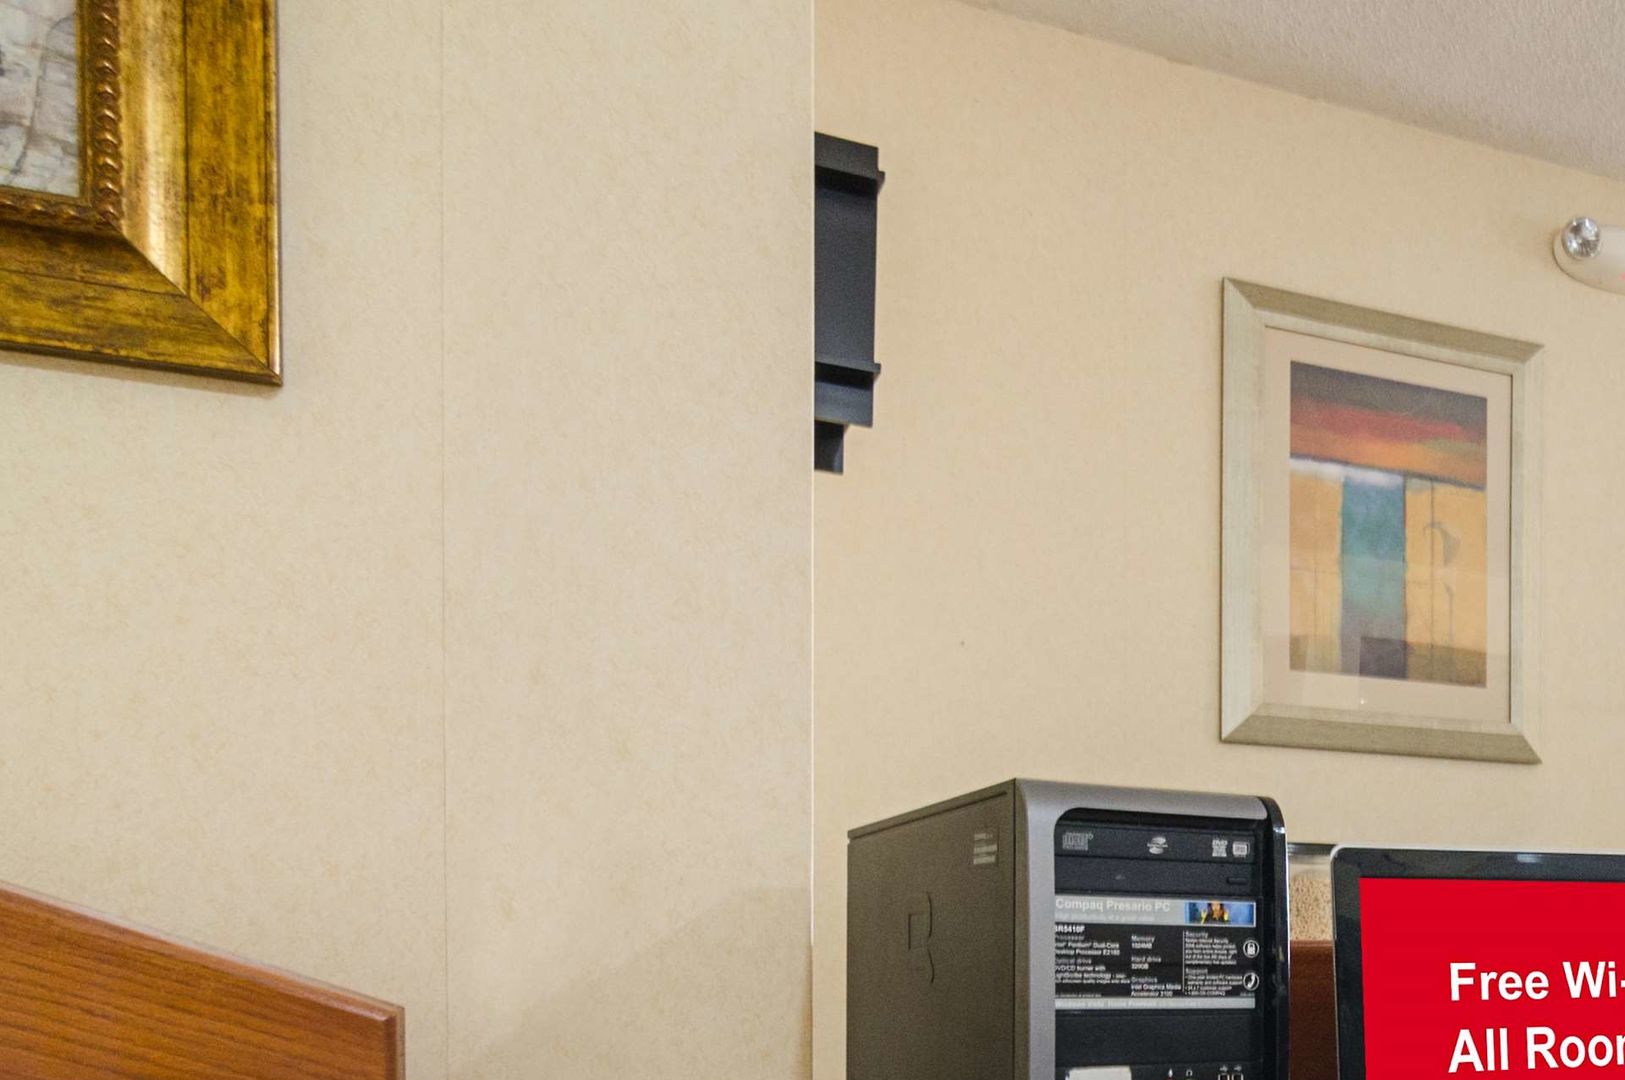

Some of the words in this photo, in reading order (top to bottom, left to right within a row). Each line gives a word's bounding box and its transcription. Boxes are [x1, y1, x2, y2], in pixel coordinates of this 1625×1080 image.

[1055, 898, 1104, 912] Compaq
[1106, 899, 1153, 912] Presario
[1154, 901, 1170, 912] PC
[1450, 962, 1550, 1001] Free
[1448, 1028, 1509, 1073] All
